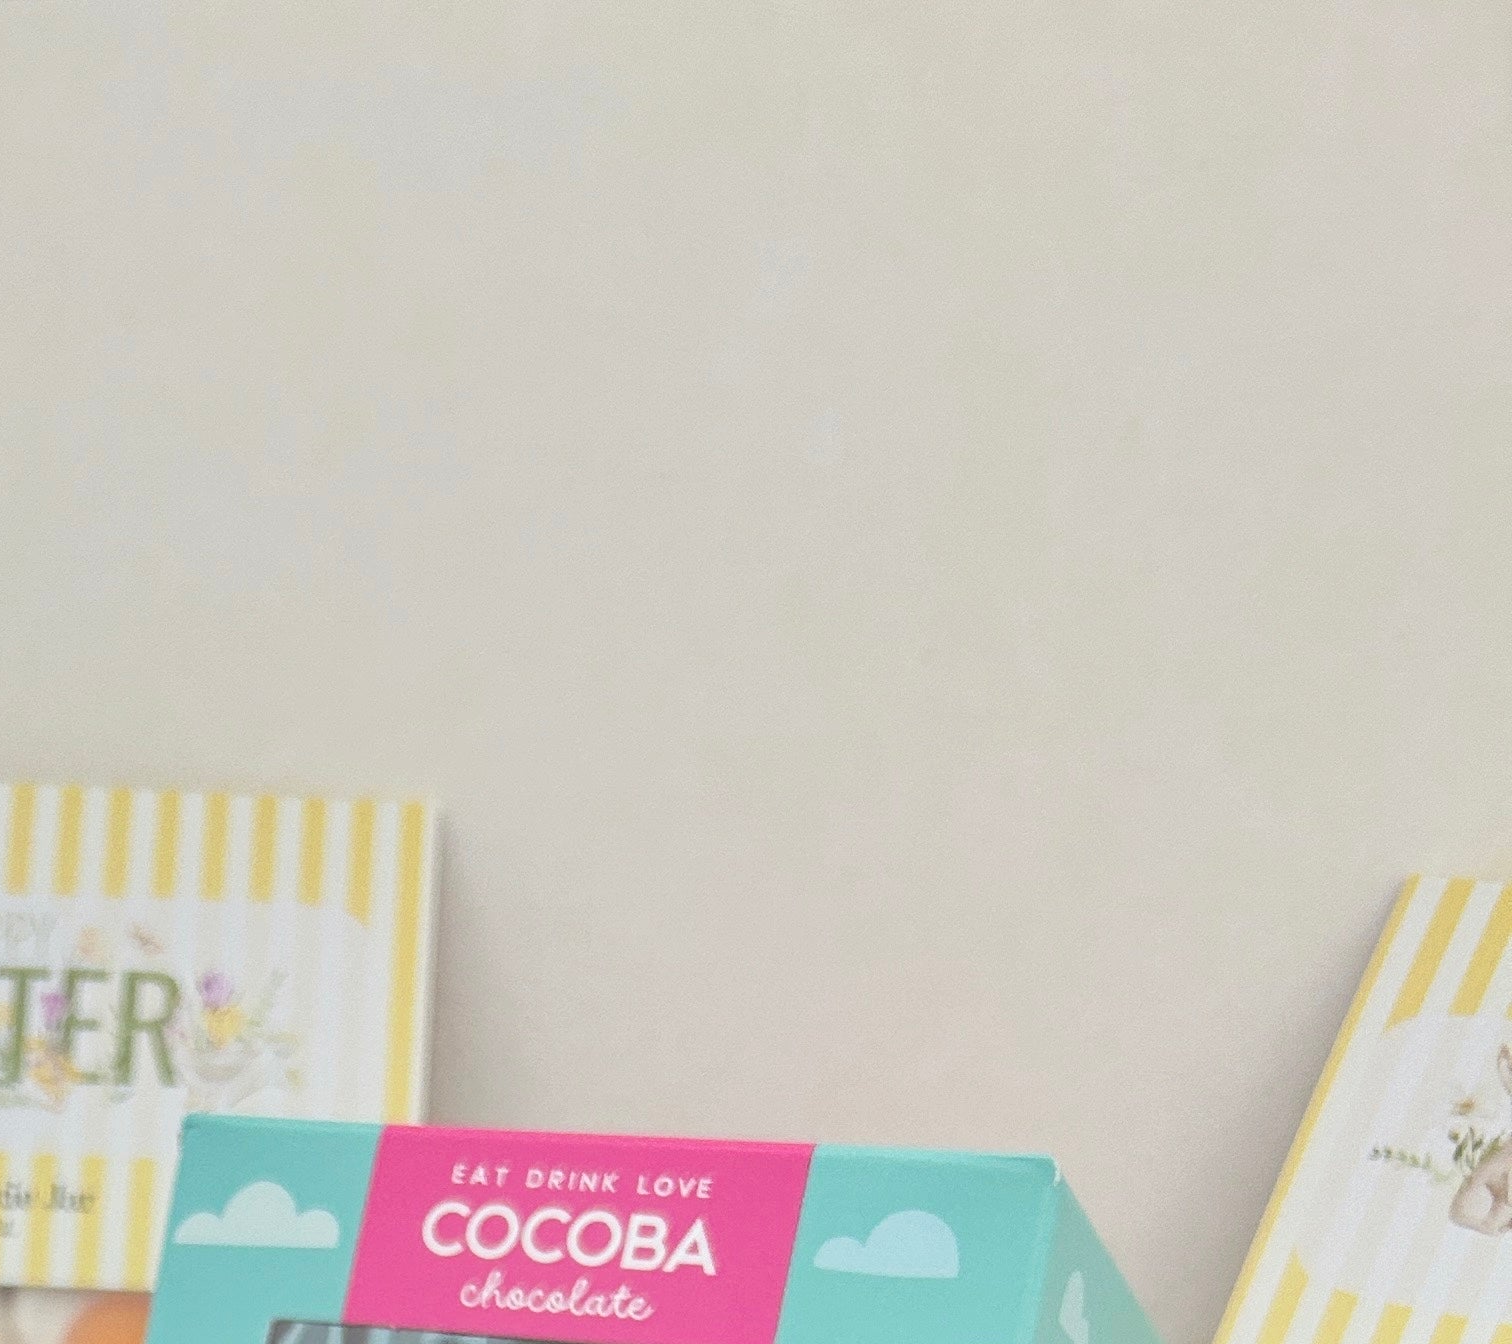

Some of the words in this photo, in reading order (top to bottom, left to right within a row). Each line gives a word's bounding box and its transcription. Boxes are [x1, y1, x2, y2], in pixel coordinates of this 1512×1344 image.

[450, 1162, 509, 1187] EAT
[524, 1168, 620, 1193] DRINK
[637, 1174, 714, 1199] LOVE
[421, 1199, 718, 1277] COCOBA
[459, 1268, 656, 1322] chocolate
